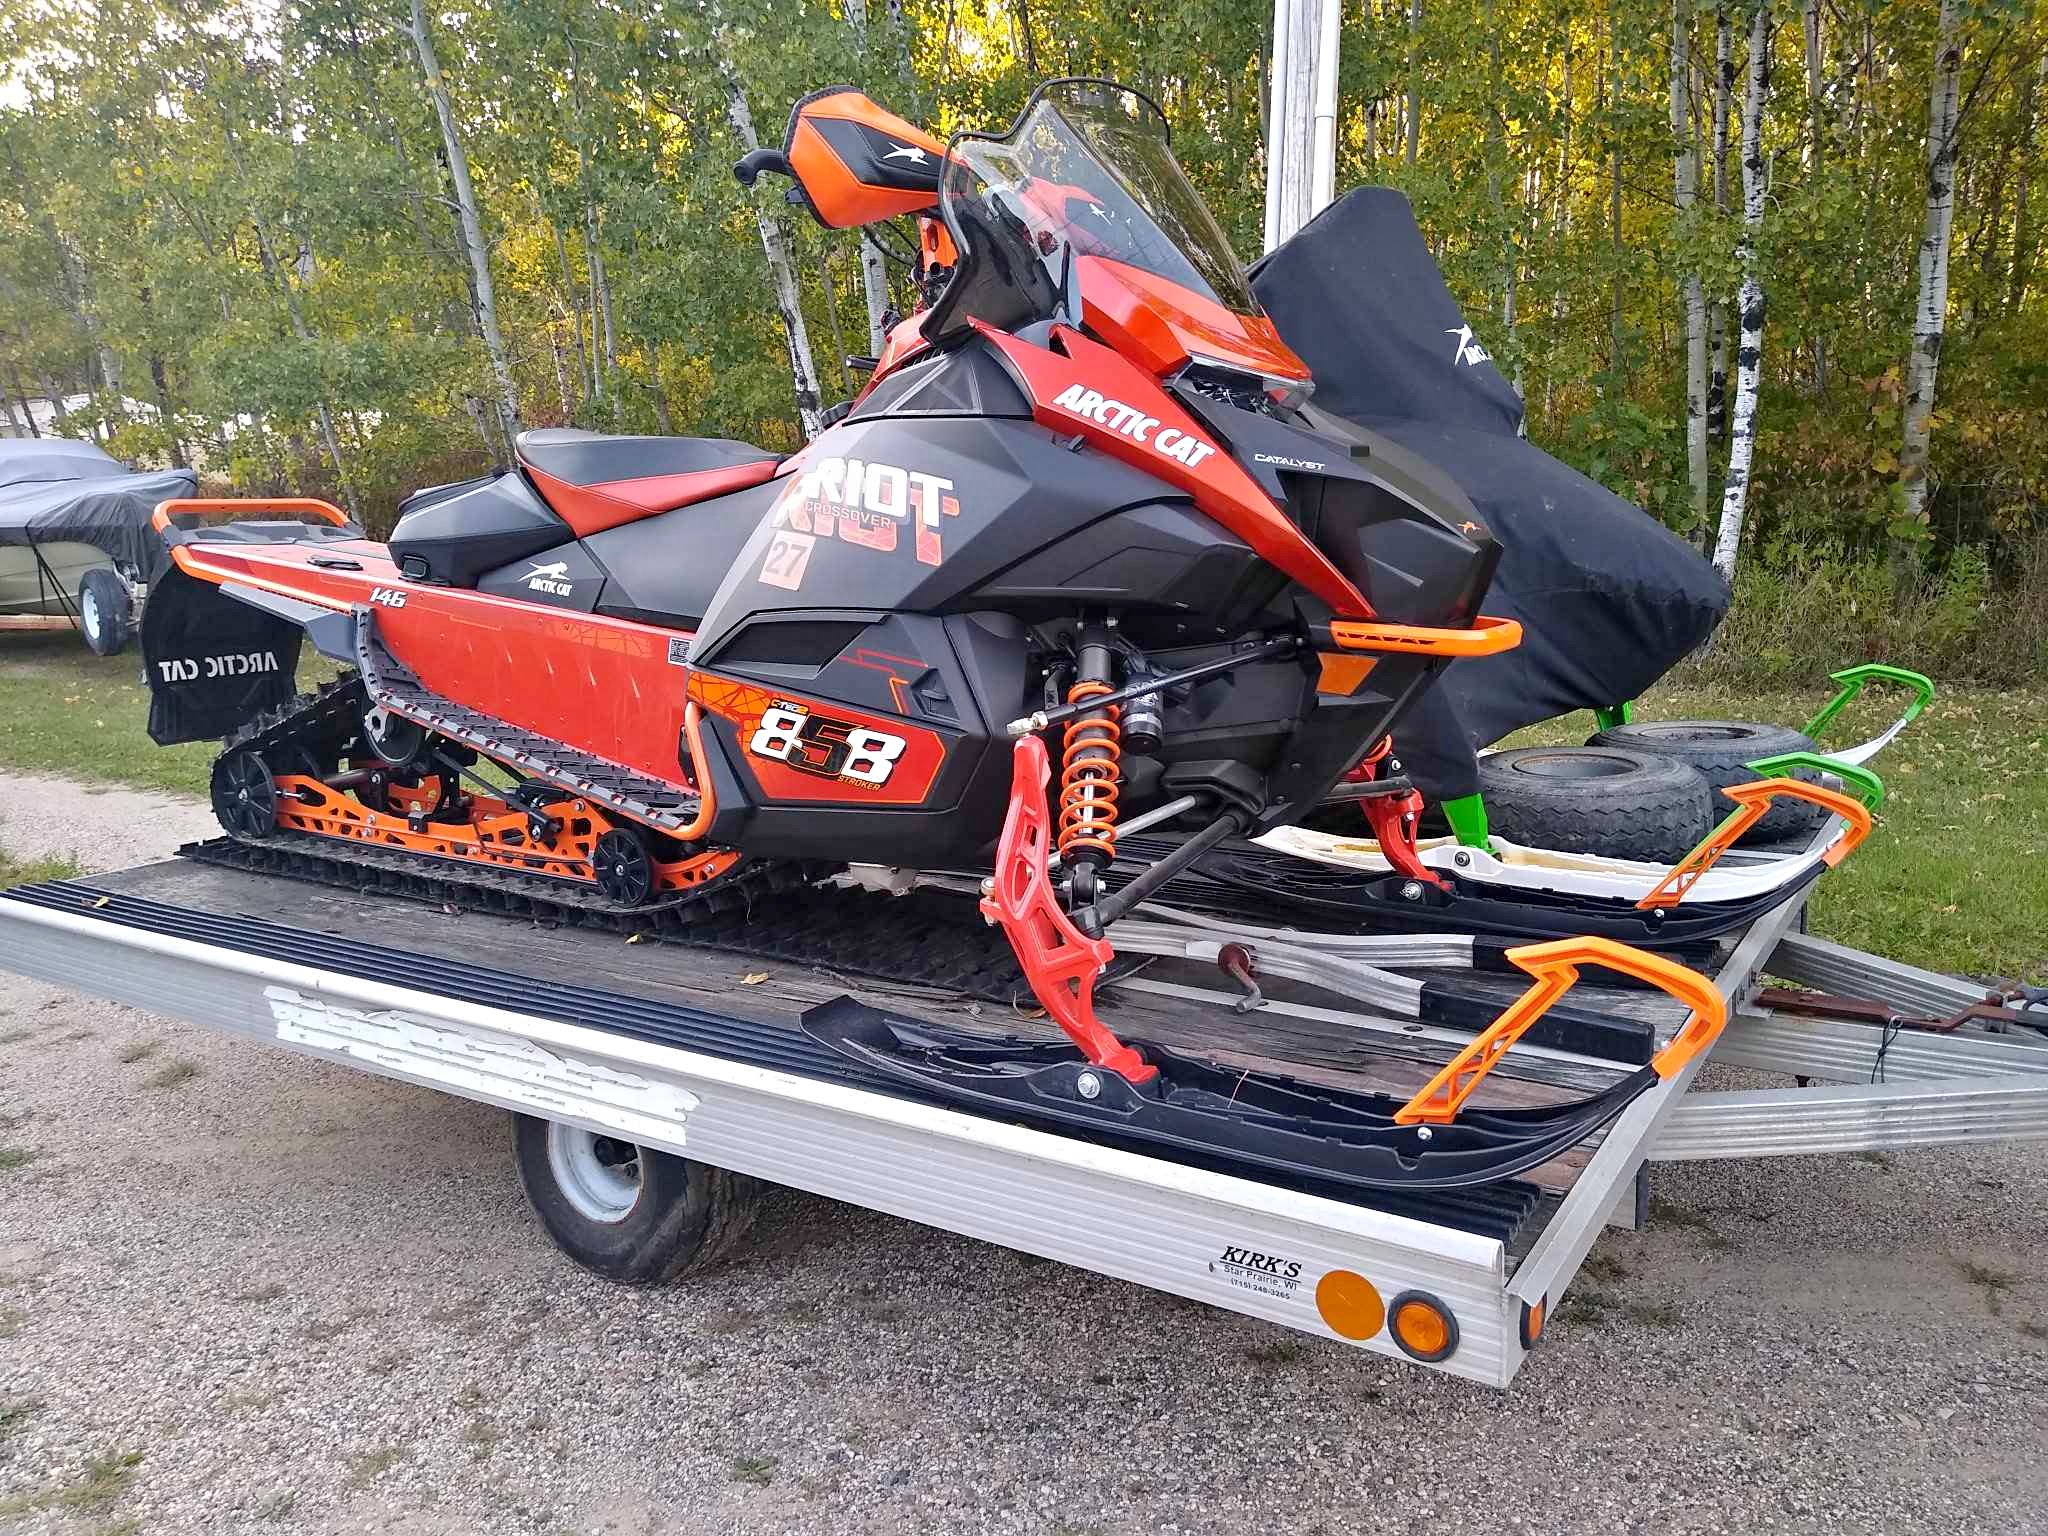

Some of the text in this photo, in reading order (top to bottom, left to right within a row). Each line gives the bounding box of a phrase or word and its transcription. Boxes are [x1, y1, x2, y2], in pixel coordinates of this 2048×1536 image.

[1052, 383, 1216, 468] ARCTIC CAT
[1254, 453, 1325, 470] CATALYST
[802, 456, 954, 529] RIOT
[804, 501, 891, 529] CROSSOVER
[765, 541, 809, 577] 27
[370, 587, 408, 607] 146
[528, 577, 572, 597] ARCTIC CAT
[750, 707, 907, 784] 858
[836, 775, 881, 792] STROKER
[1220, 1245, 1302, 1278] KIRK'S
[1224, 1265, 1244, 1276] Star
[1284, 1280, 1297, 1291] WI
[1231, 1277, 1251, 1289] (715)
